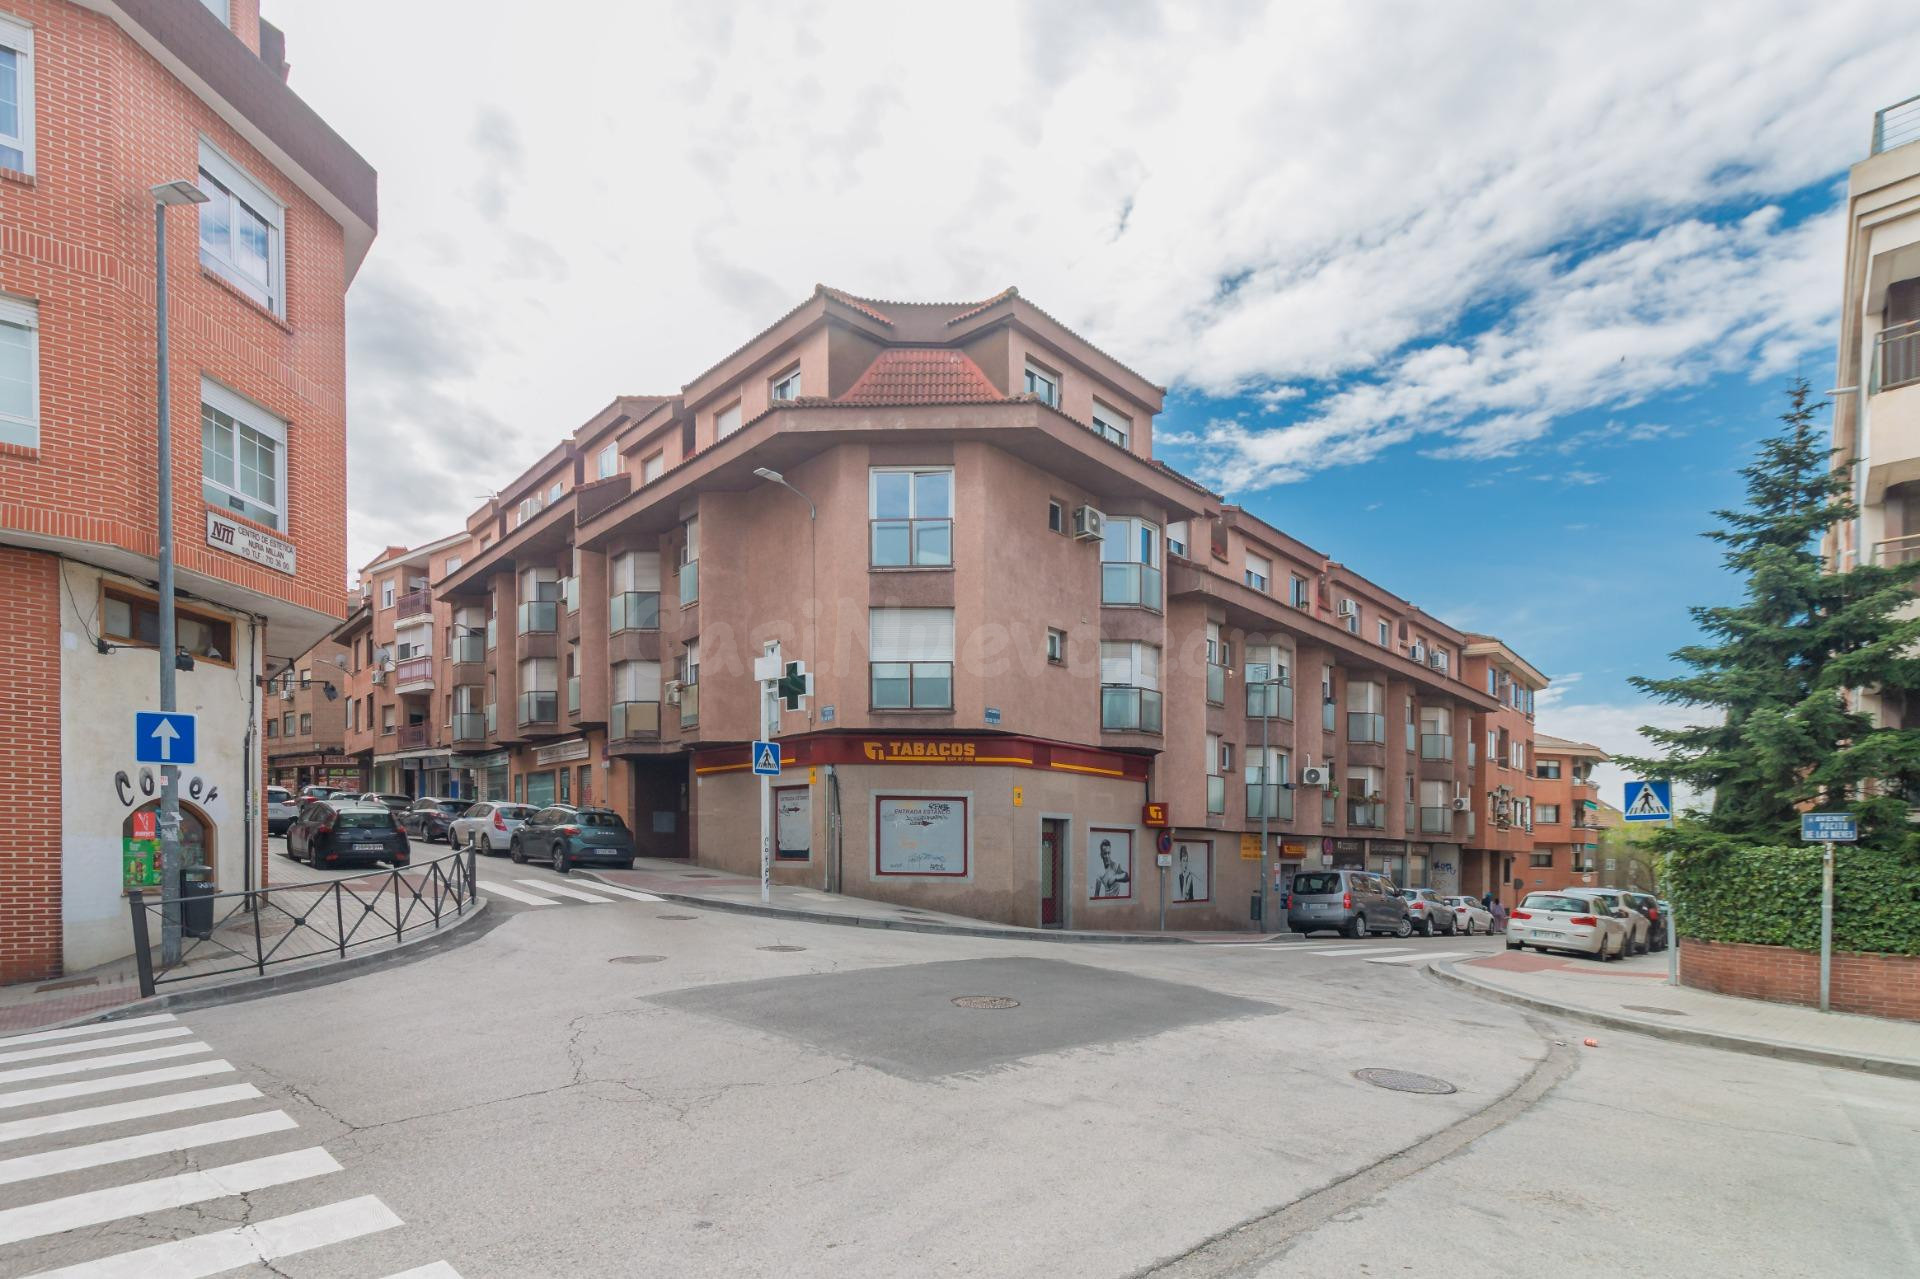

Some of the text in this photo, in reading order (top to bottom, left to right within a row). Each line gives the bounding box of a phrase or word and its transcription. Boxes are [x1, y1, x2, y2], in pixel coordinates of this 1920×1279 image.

[238, 526, 294, 554] CENTRO DE ESTETICA
[248, 539, 264, 552] NURIA
[889, 742, 976, 756] TABACOS
